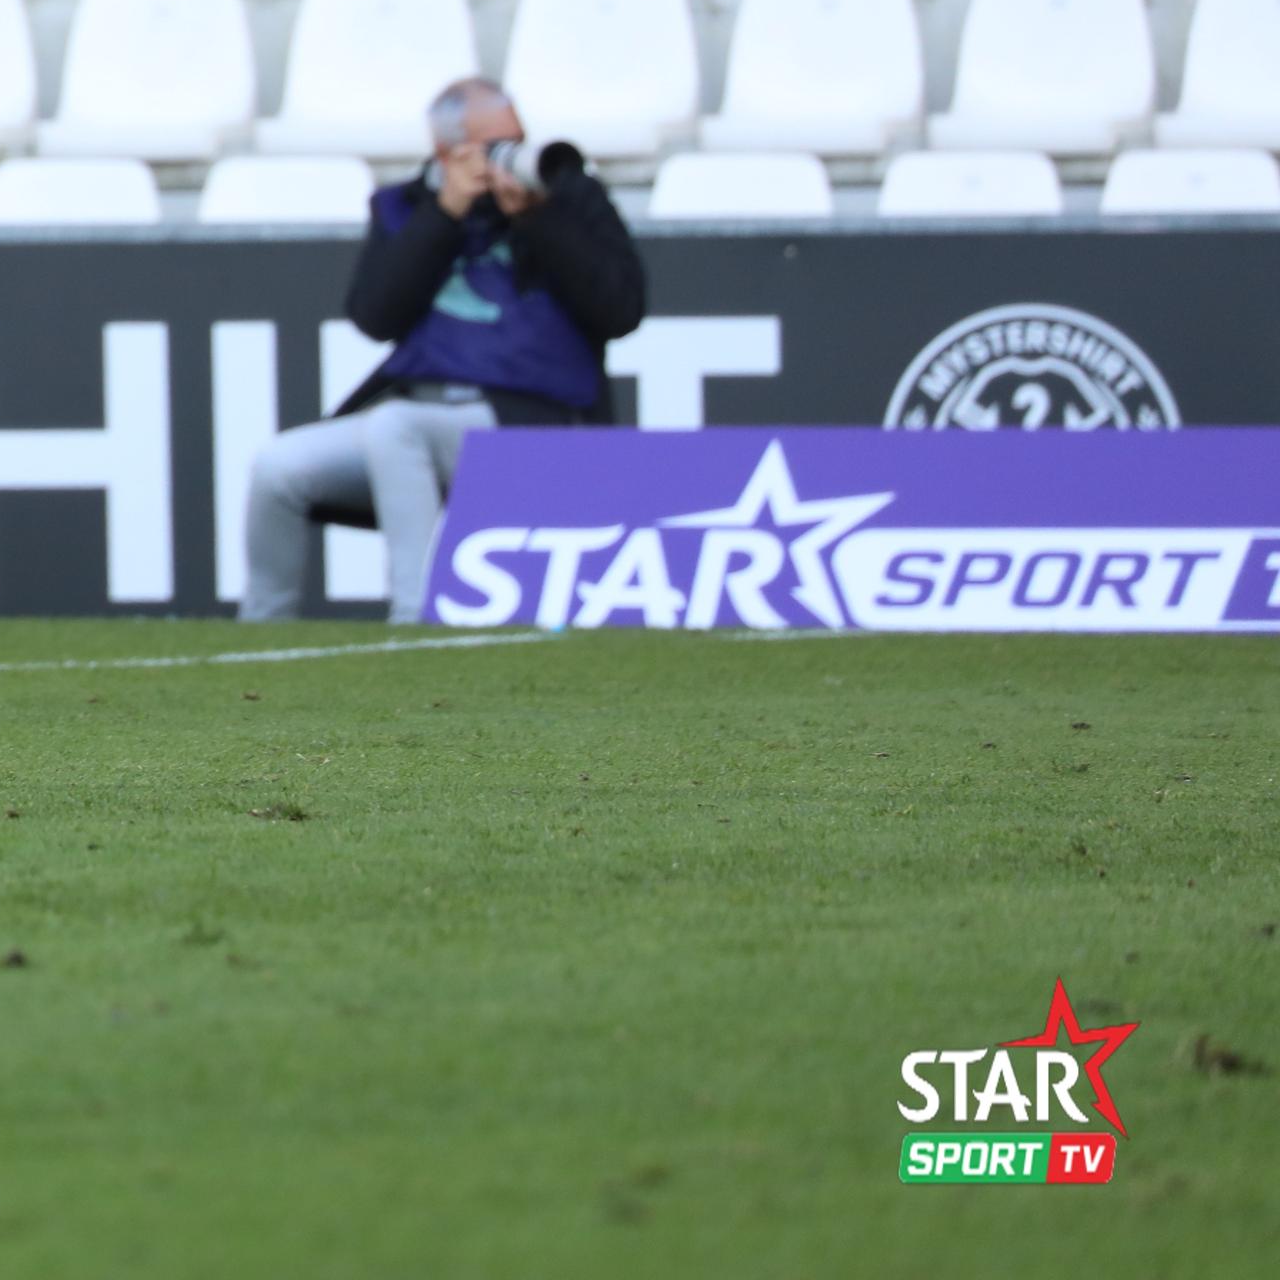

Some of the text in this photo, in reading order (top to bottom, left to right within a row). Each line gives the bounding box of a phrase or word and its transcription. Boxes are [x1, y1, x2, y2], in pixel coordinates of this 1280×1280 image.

[917, 320, 1142, 403] MYSTERSHIRT
[435, 522, 792, 632] STAR
[876, 547, 1222, 609] SPORT
